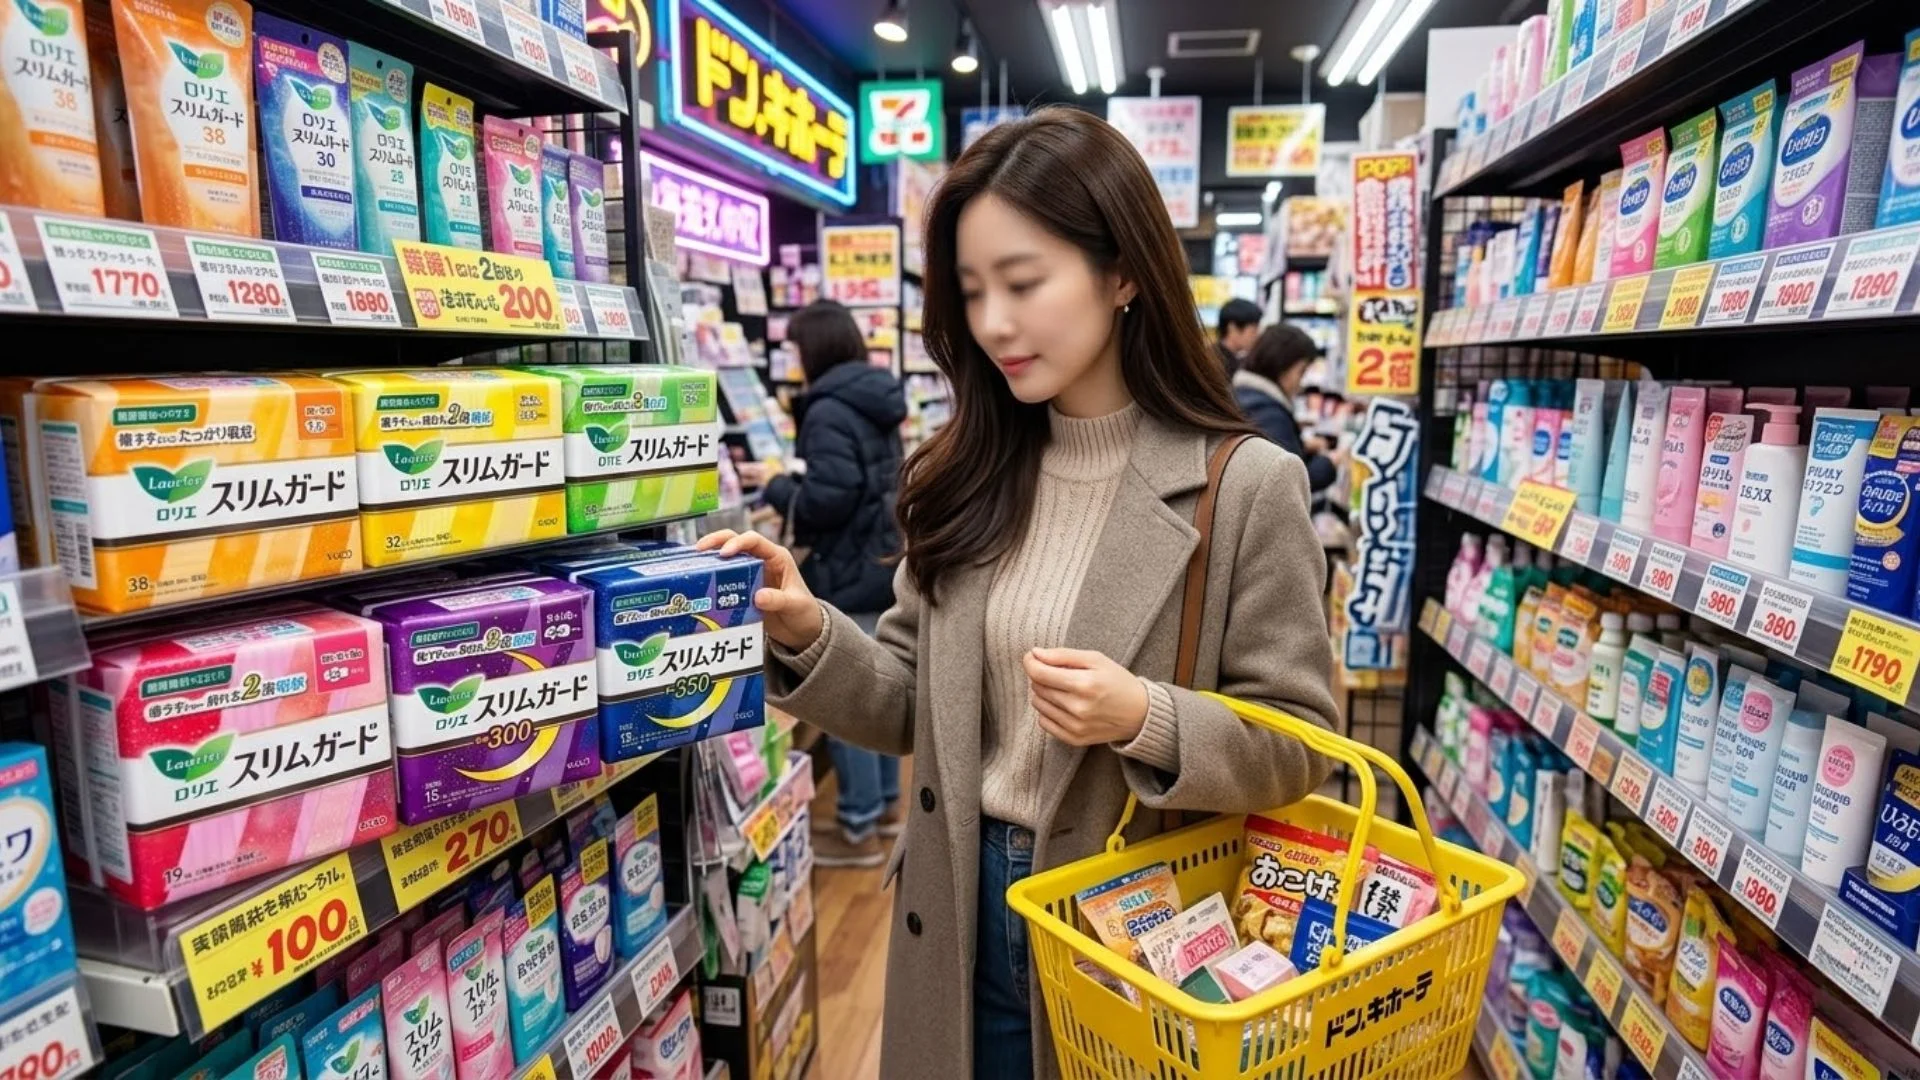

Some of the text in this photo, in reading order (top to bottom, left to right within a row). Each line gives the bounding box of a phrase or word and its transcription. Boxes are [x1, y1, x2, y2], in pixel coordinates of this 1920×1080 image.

[53, 88, 77, 111] 38
[184, 81, 229, 105] ロリエ
[203, 126, 226, 145] 38
[316, 151, 336, 168] 30
[91, 267, 160, 298] 1770
[228, 280, 281, 306] 1280
[499, 284, 553, 321] 200
[627, 434, 710, 463] スリムガード
[438, 450, 550, 488] スリムガード
[207, 470, 346, 516] スリムガード
[157, 506, 197, 521] ロリエ
[385, 534, 400, 548] 32
[128, 576, 149, 592] 38
[659, 636, 753, 676] スリムガード
[1852, 645, 1903, 686] 1790
[474, 675, 588, 722] スリムガード
[487, 718, 531, 748] 300
[229, 722, 378, 789] スリムガード
[175, 780, 219, 802] ロリエ
[425, 788, 439, 803] 15
[444, 810, 510, 873] 270
[164, 867, 183, 884] 19
